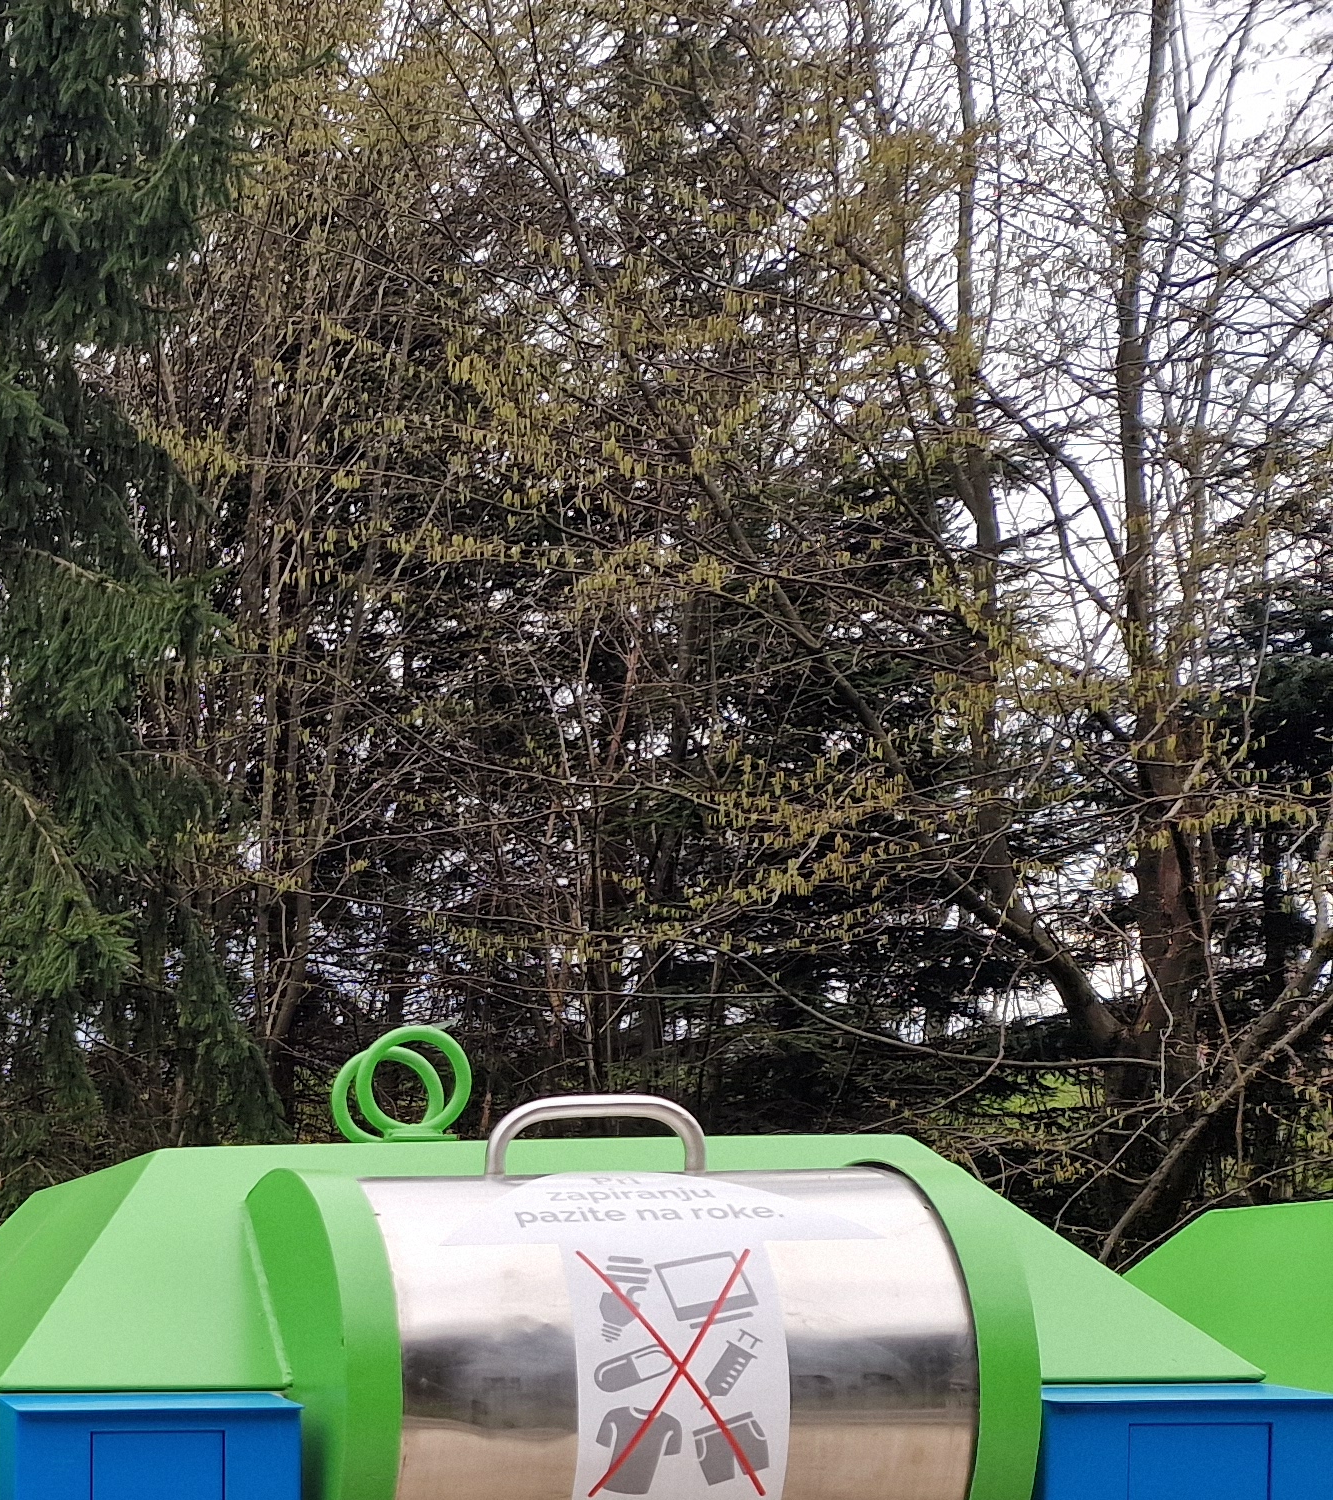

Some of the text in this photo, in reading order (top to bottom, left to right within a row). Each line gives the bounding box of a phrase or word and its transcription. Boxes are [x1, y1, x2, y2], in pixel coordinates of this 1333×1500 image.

[546, 1187, 716, 1204] zapiranju
[514, 1204, 784, 1228] pazite na roke.
